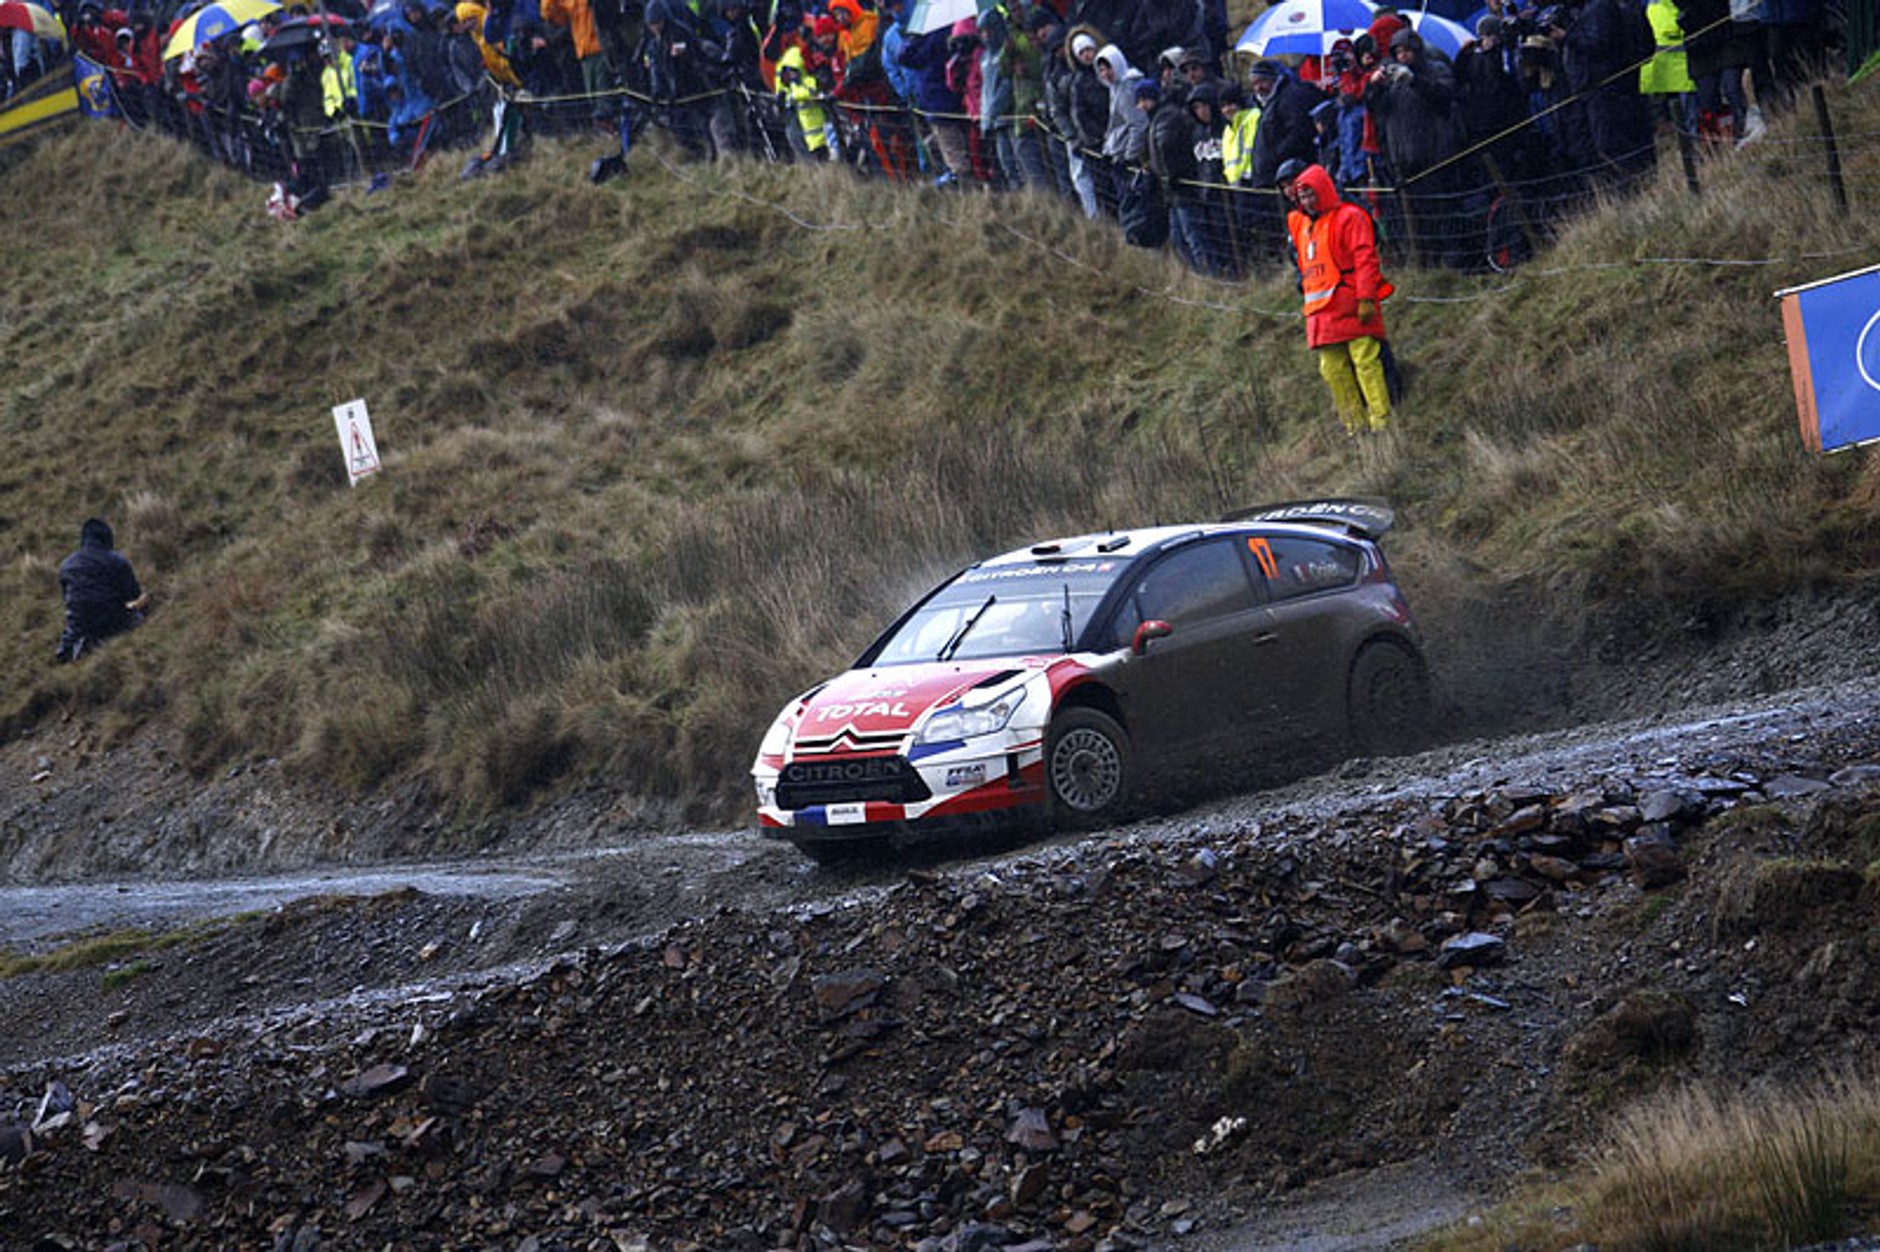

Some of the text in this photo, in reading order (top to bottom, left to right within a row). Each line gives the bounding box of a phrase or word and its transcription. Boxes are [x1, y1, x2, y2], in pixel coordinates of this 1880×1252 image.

[1247, 537, 1279, 579] 17
[817, 701, 911, 722] TOTAL
[787, 758, 900, 782] CITROËN
